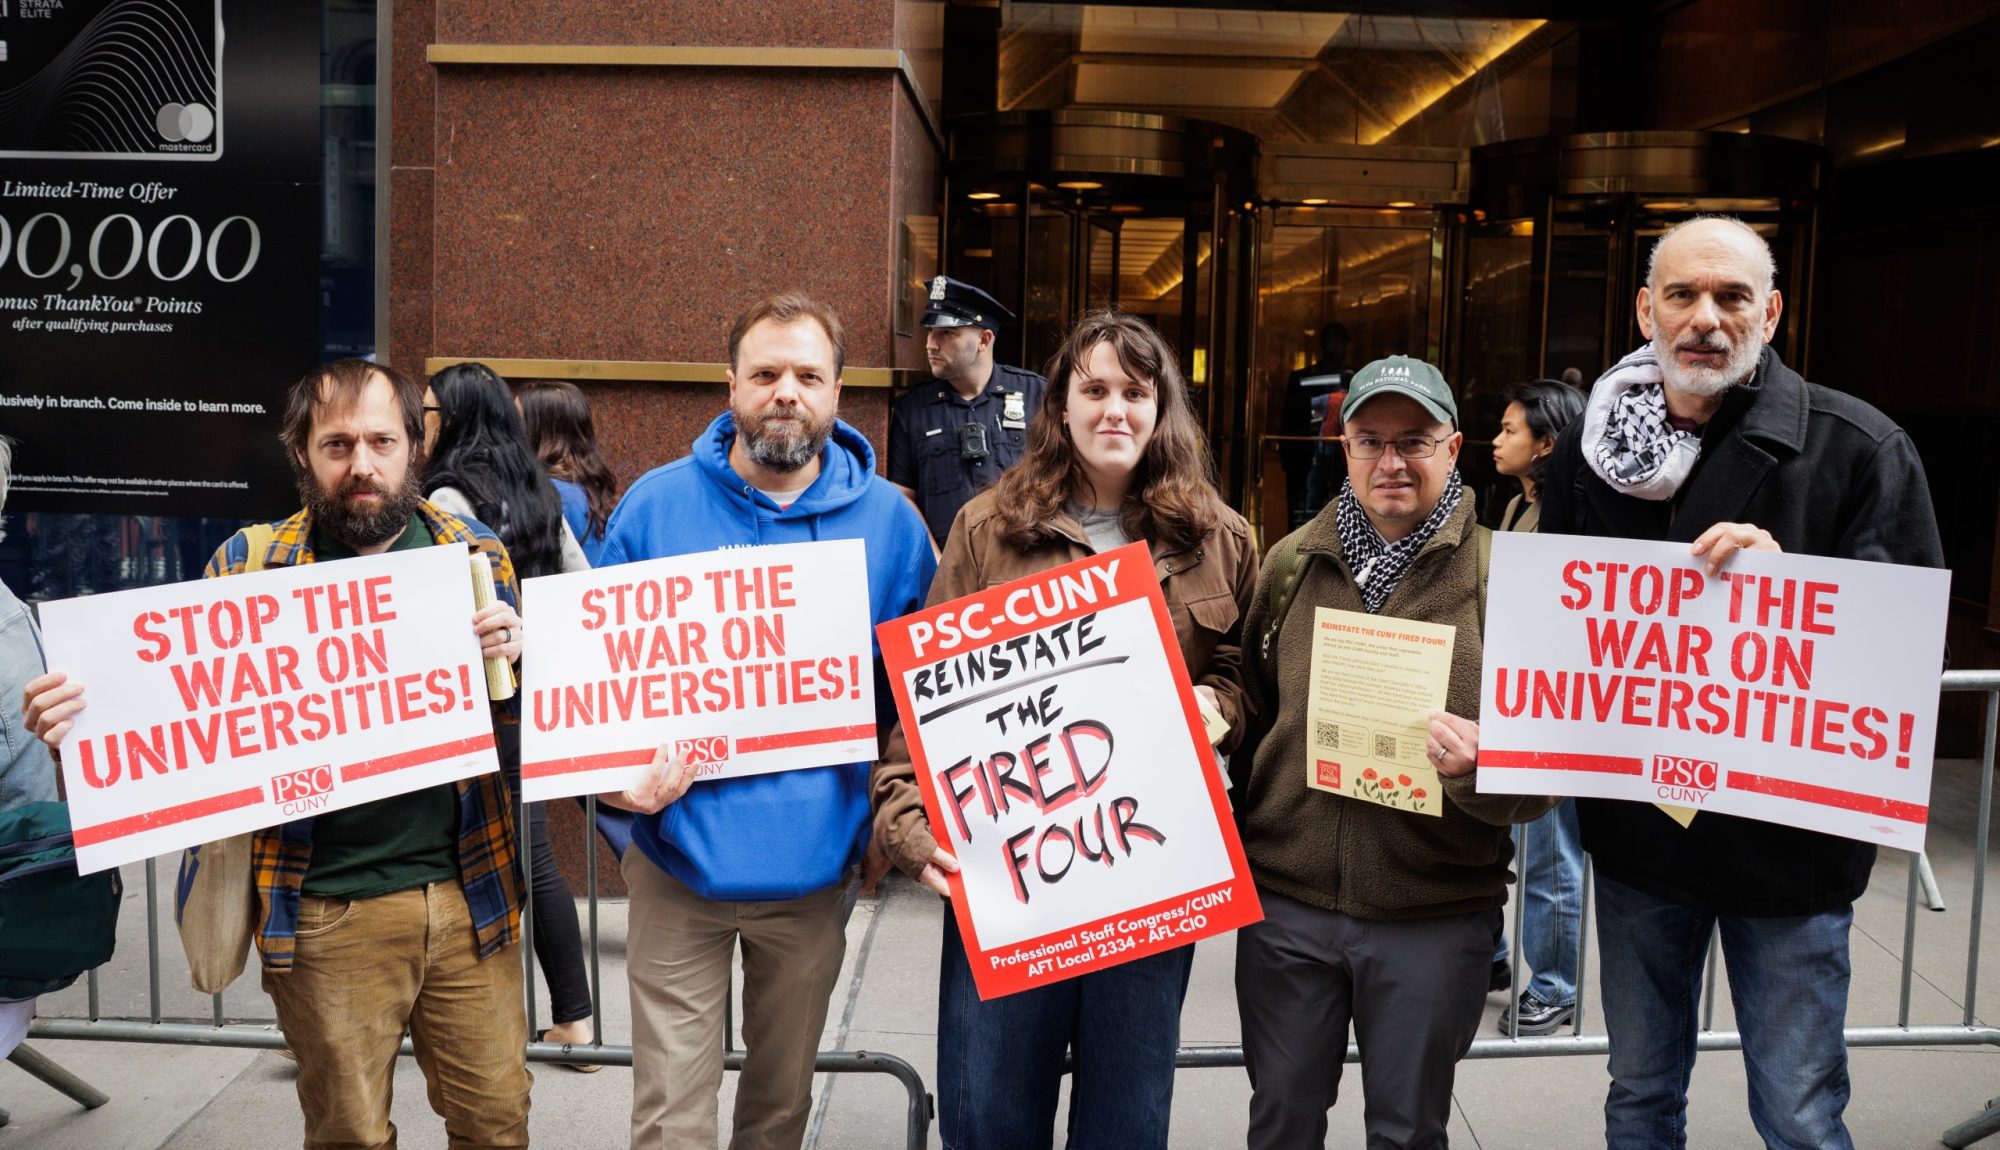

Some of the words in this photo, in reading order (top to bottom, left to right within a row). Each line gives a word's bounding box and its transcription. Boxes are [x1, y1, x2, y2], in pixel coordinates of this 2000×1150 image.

[20, 0, 63, 9] STRATA
[20, 9, 51, 18] ELITE
[159, 143, 212, 152] mastercard
[3, 181, 124, 199] Limited-Time
[129, 182, 177, 203] Offer
[12, 317, 43, 331] after
[46, 319, 109, 333] qualifying
[111, 321, 173, 333] purchases
[146, 297, 202, 313] Points
[46, 395, 58, 407] in
[60, 396, 106, 409] branch.
[108, 397, 144, 410] Come
[146, 398, 182, 411] inside
[183, 401, 197, 411] to
[199, 400, 229, 412] learn
[232, 404, 266, 413] more.
[133, 595, 280, 662] STOP
[292, 576, 396, 634] THE
[583, 576, 692, 629] STOP
[705, 565, 796, 612] THE
[908, 559, 1120, 658] PSC-CUNY
[1561, 560, 1704, 617] STOP
[1721, 573, 1839, 635] THE
[604, 622, 707, 672] WAR
[722, 614, 784, 661] ON
[914, 613, 1105, 701] REINSTATE
[1321, 622, 1360, 634] REINSTATE
[1361, 628, 1375, 636] THE
[1376, 630, 1396, 640] CUNY
[1399, 633, 1420, 643] FIRED
[1422, 637, 1446, 647] FOUR!
[1586, 617, 1712, 677] WAR
[1730, 632, 1814, 690] ON
[170, 646, 302, 711] WAR
[317, 629, 387, 684] ON
[534, 656, 860, 731] UNIVERSITIES!
[79, 664, 473, 789] UNIVERSITIES!
[987, 685, 1062, 735] THE
[1495, 668, 1915, 769] UNIVERSITIES!
[272, 765, 334, 803] PSC
[938, 720, 1113, 844] FIRED
[1653, 755, 1717, 790] PSC
[1656, 785, 1709, 804] CUNY
[282, 795, 329, 817] CUNY
[1003, 797, 1166, 903] FOUR
[991, 935, 1077, 968] Professional
[1081, 923, 1114, 944] Staff
[1119, 888, 1231, 932] Congress/CUNY
[1029, 959, 1052, 976] AFT
[1057, 947, 1094, 968] Local
[1099, 936, 1135, 957] 2334
[1149, 915, 1206, 943] AFL-CIO
